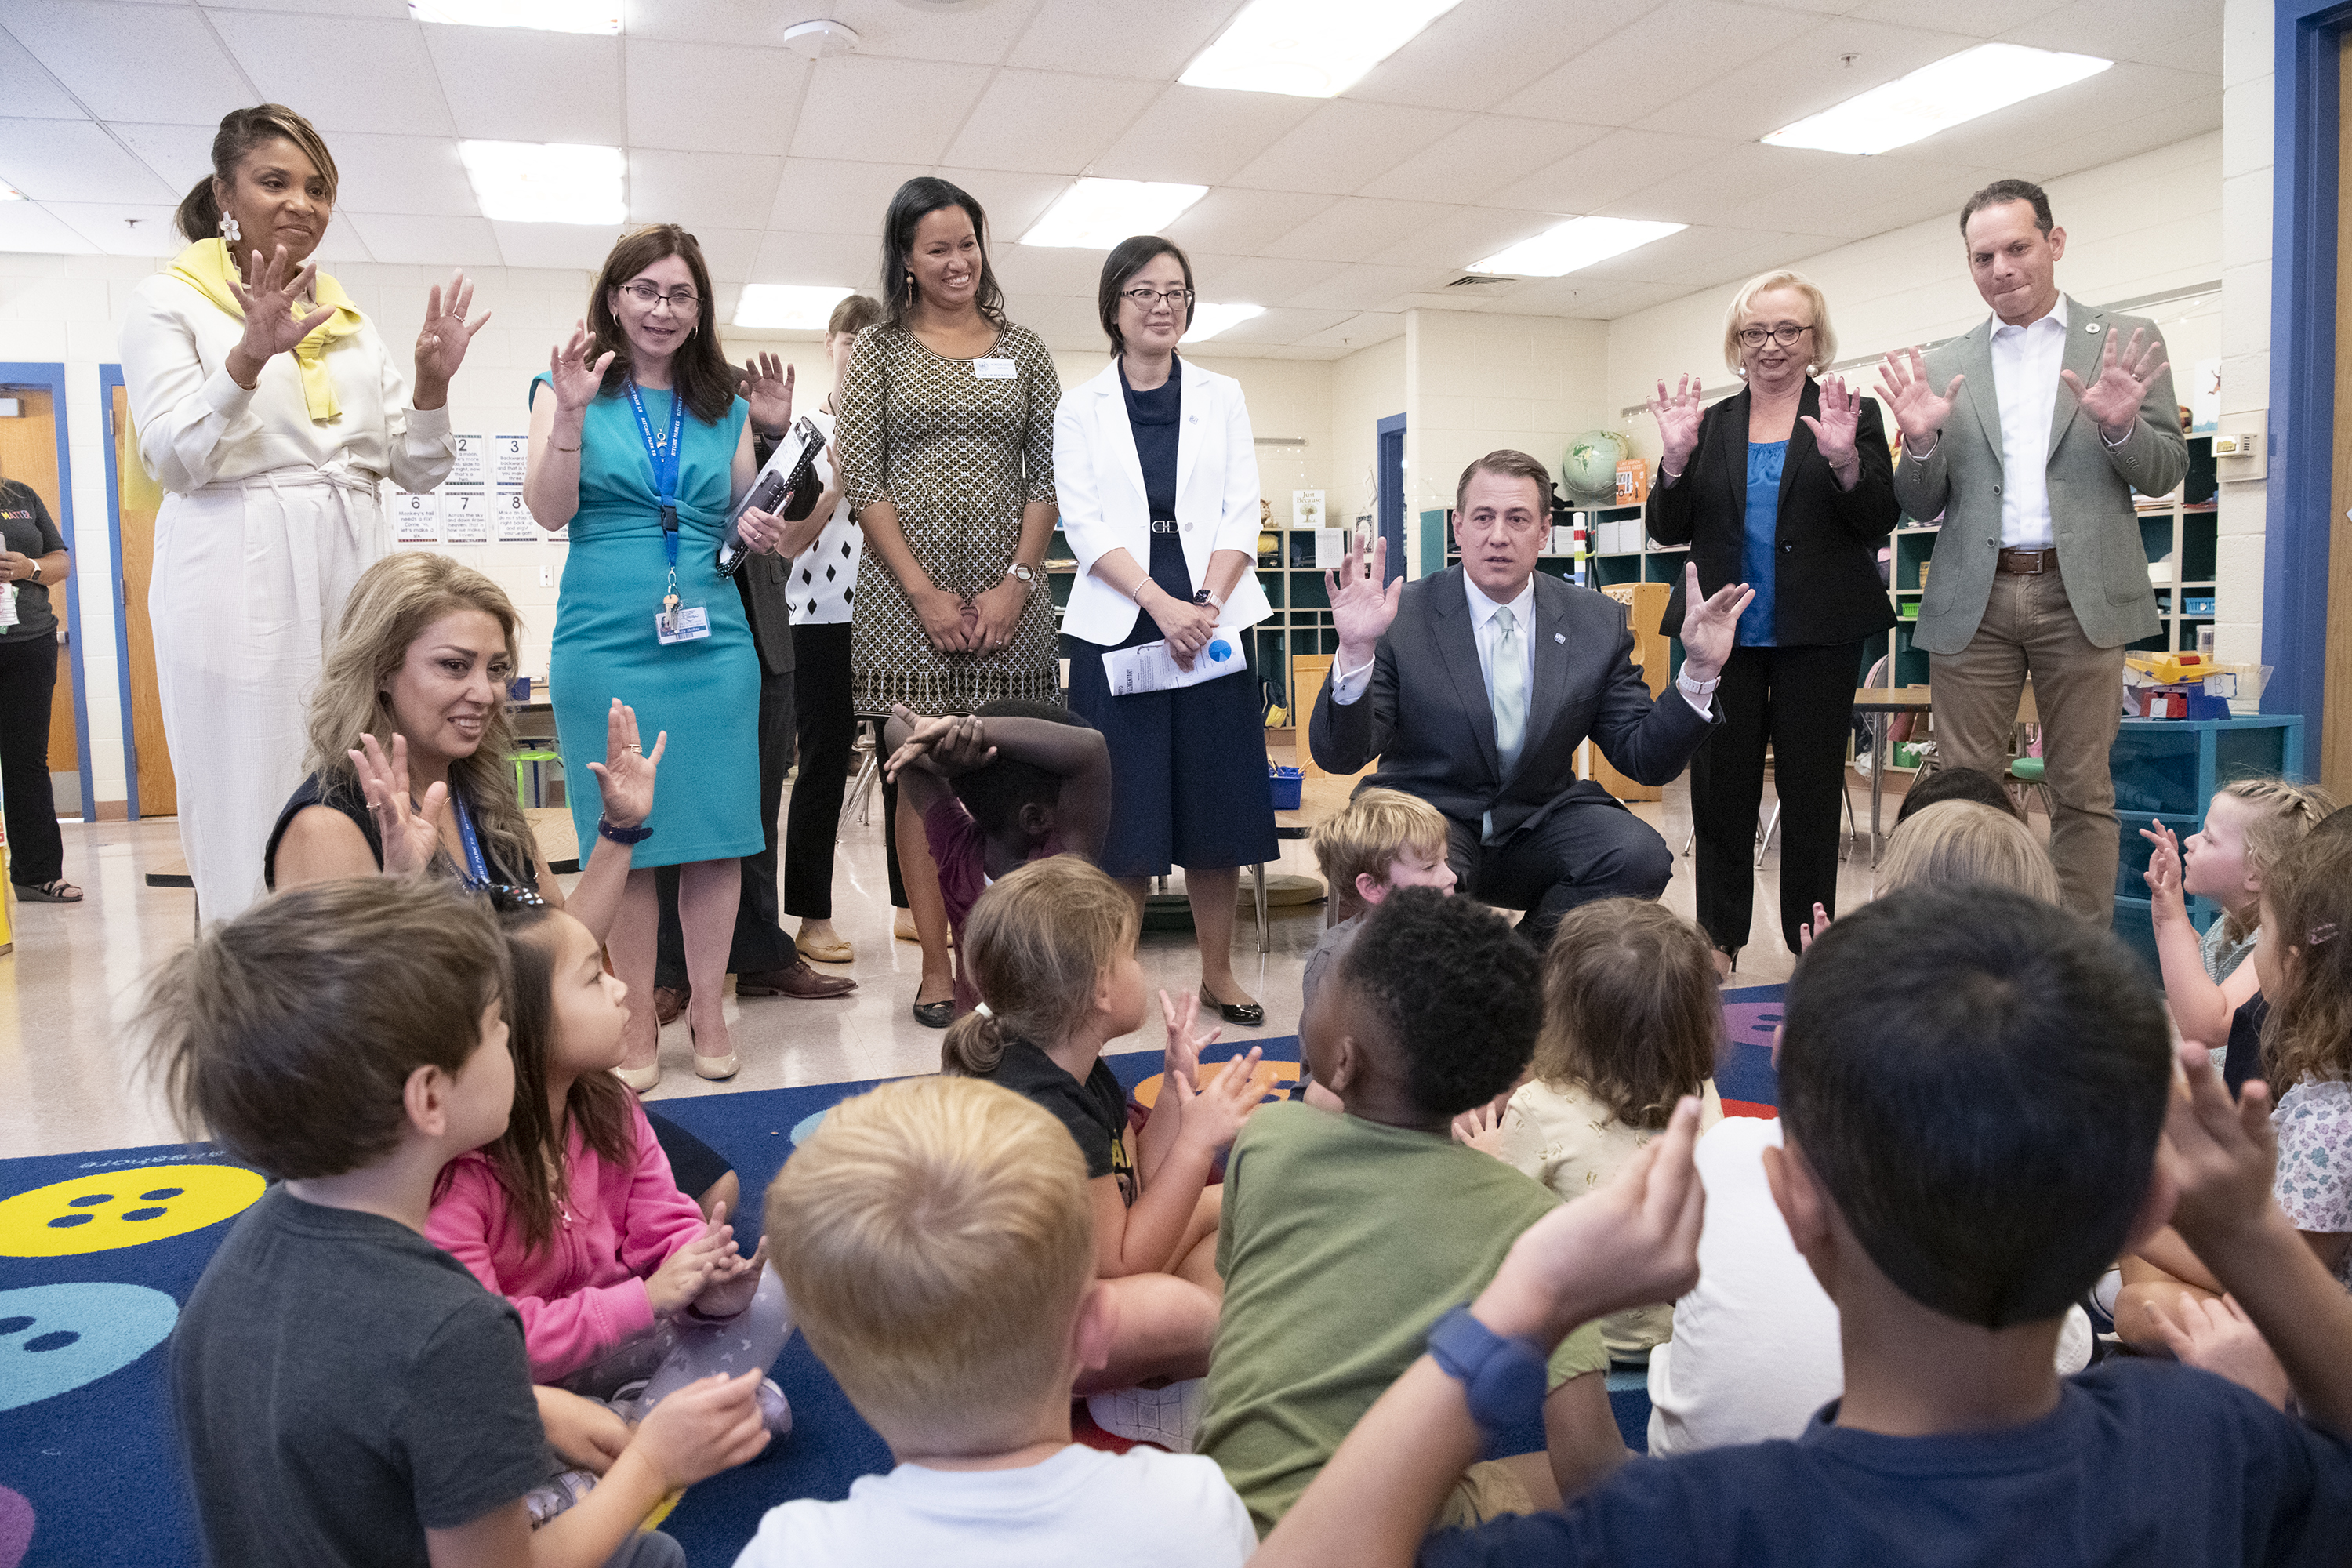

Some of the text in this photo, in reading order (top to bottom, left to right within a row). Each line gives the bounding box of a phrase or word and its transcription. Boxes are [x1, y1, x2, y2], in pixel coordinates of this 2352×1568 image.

[459, 439, 467, 452] 2
[510, 441, 519, 452] 3
[647, 436, 655, 452] PARK
[411, 496, 420, 509] 6
[461, 497, 469, 510] 7
[512, 496, 521, 509] 8
[1, 510, 32, 520] MATTER
[2214, 677, 2223, 694] B
[2152, 699, 2163, 715] C
[472, 846, 481, 863] PARK
